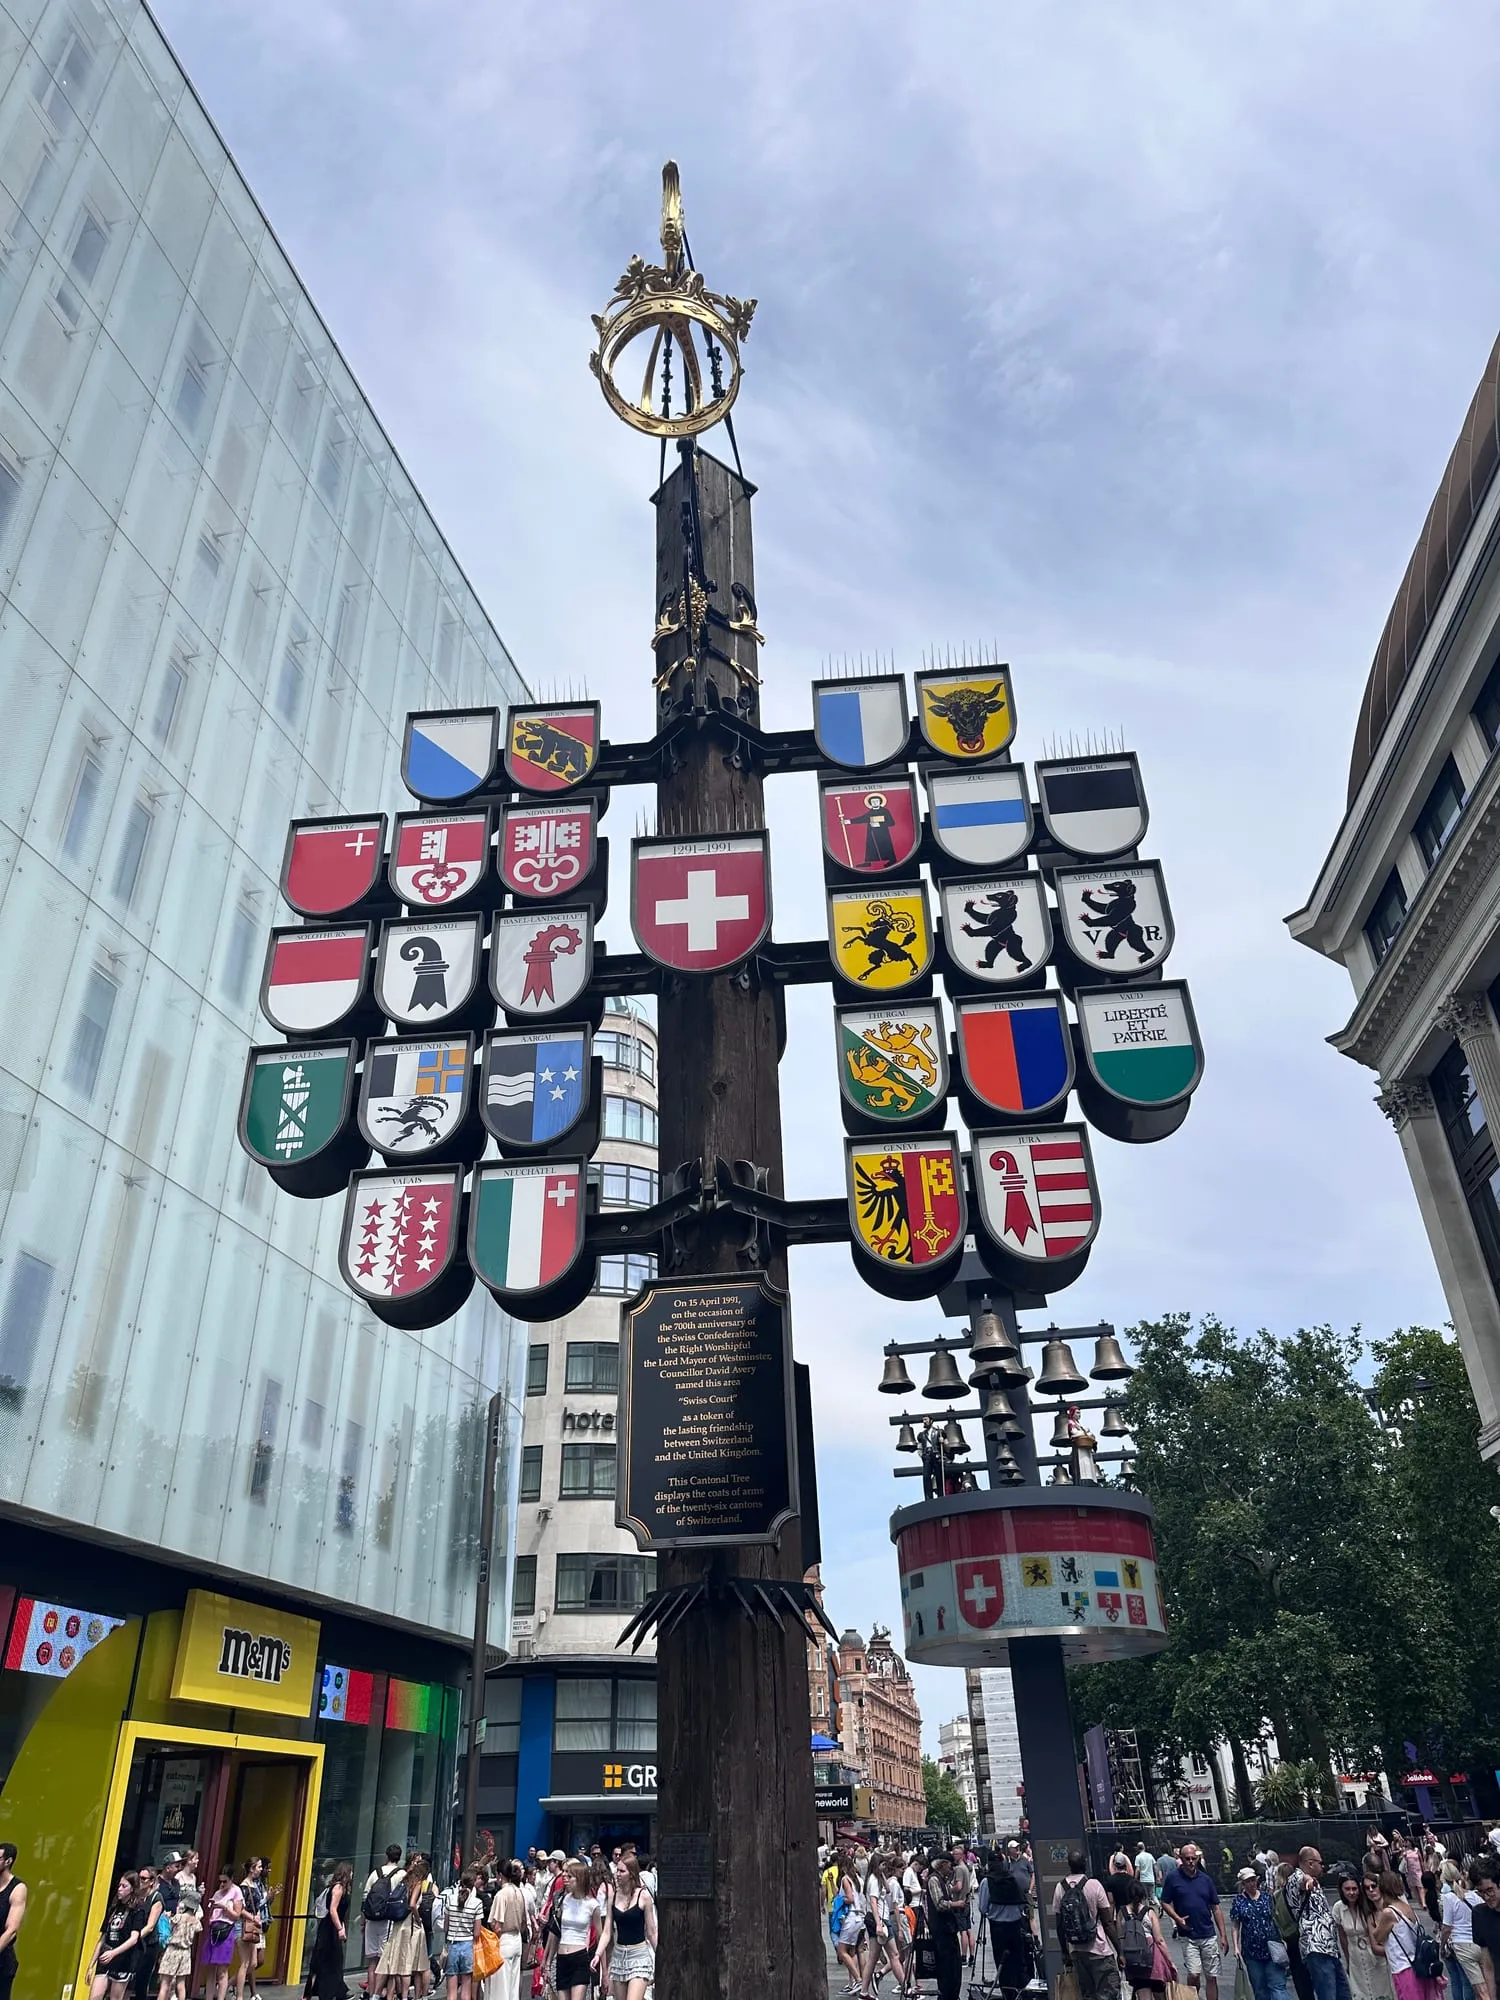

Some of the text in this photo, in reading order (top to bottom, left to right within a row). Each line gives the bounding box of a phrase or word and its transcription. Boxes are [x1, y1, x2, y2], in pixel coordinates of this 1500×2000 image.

[1066, 764, 1107, 773] FRIBOURG
[852, 784, 883, 792] GLARUS
[526, 807, 573, 817] NIDWALDEN
[422, 816, 465, 825] OBWALDEN
[1073, 871, 1118, 881] APPENZELL
[958, 881, 1005, 892] APPENZELL
[845, 889, 909, 900] SCHAFFHAUSEN
[503, 913, 584, 925] BASEL-LANDSCHAFT
[406, 922, 458, 932] BASEL-STADT
[297, 931, 346, 941] SOLOTHURN
[1083, 925, 1163, 945] V R
[1120, 992, 1144, 1000] VAUD
[992, 1002, 1024, 1010] TICINO
[868, 1010, 909, 1019] THURGAU
[1104, 1003, 1168, 1022] LIBERTÉ
[1126, 1019, 1148, 1031] ET
[521, 1034, 555, 1043] AARGAU
[1112, 1029, 1168, 1044] PATRIE
[292, 1051, 324, 1060] GALLEN
[1018, 1136, 1041, 1144] JURA
[392, 1176, 422, 1185] VALAIS
[673, 1296, 741, 1308] On 15 April 1991,
[684, 1310, 697, 1318] the
[698, 1308, 733, 1317] occasion
[735, 1307, 744, 1315] of
[660, 1317, 756, 1331] the 700th anniversary of
[657, 1329, 758, 1343] the Swiss Confederation,
[664, 1341, 751, 1355] the Right Worshipful
[643, 1353, 773, 1367] the Lord Mayor of Westminster,
[660, 1366, 757, 1379] Councillor David Avery
[675, 1378, 741, 1389] named this area
[700, 1412, 724, 1420] token
[725, 1410, 735, 1419] of
[663, 1422, 754, 1435] the lasting friendship
[664, 1435, 753, 1448] between Switzerland
[654, 1447, 763, 1462] and the United Kingdom.
[667, 1474, 751, 1487] This Cantonal Tree
[654, 1487, 764, 1502] displays the coats of arms
[656, 1500, 763, 1514] of the twenty-six cantons
[676, 1514, 742, 1526] of Switzerland.
